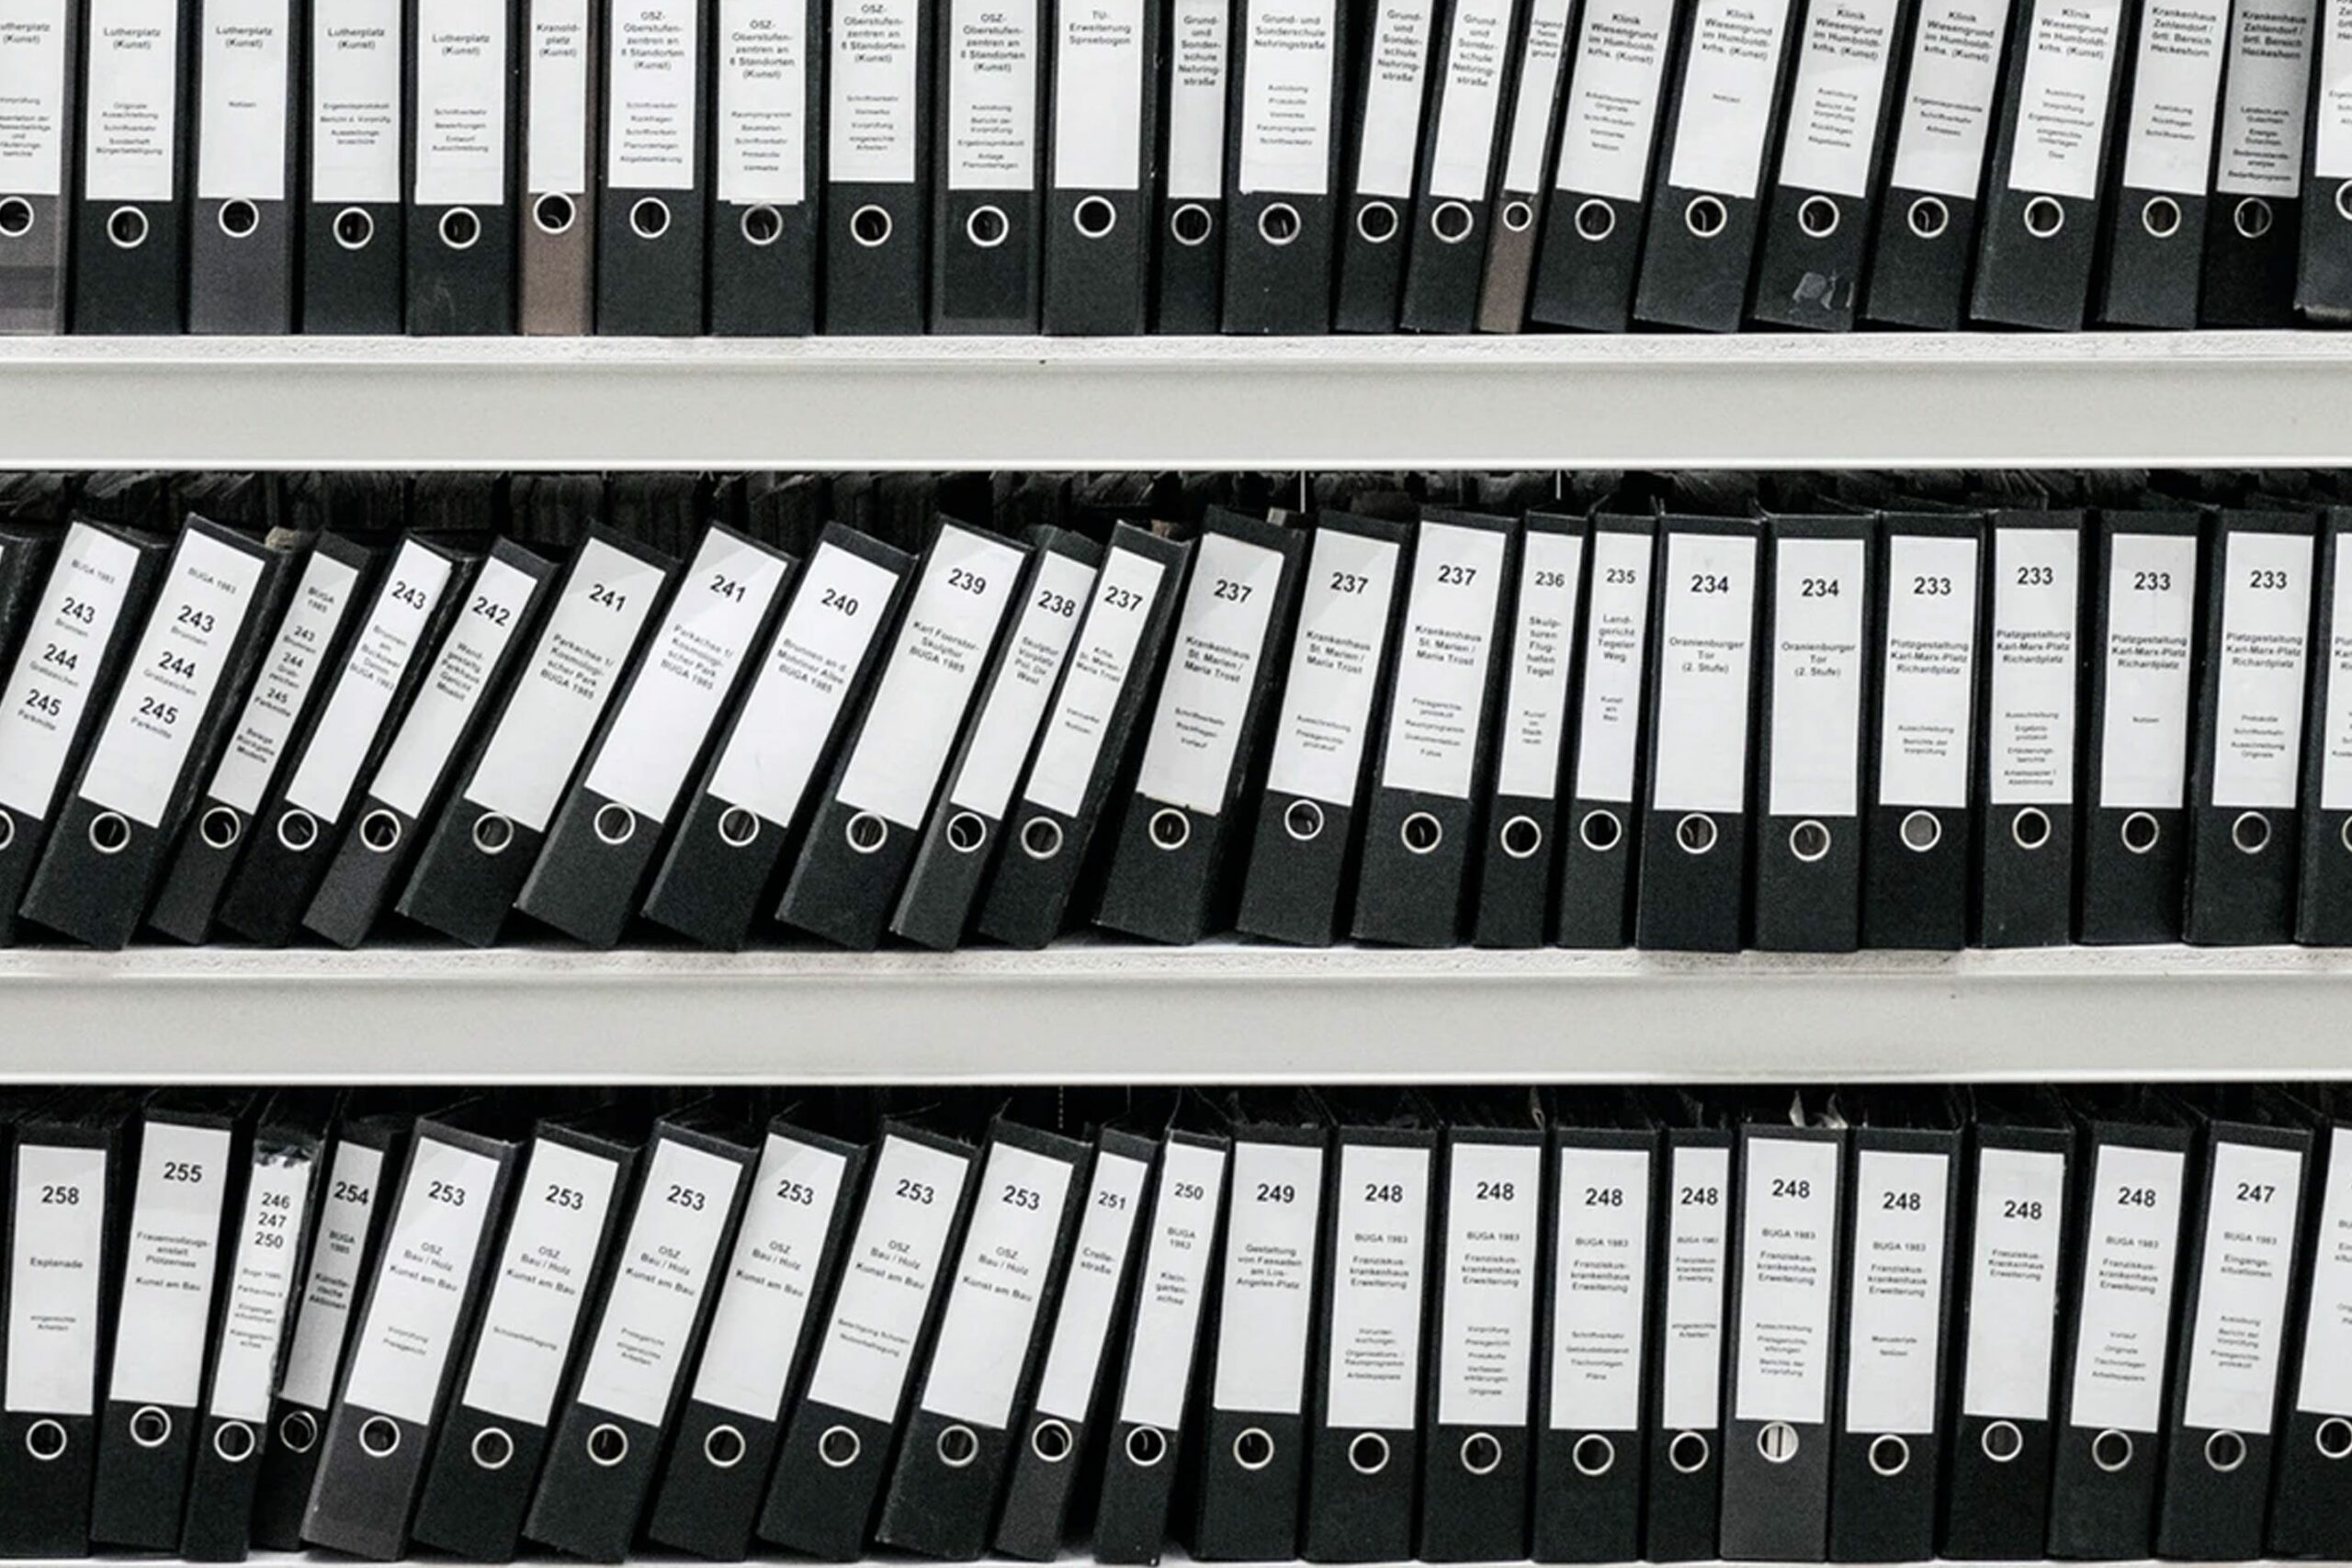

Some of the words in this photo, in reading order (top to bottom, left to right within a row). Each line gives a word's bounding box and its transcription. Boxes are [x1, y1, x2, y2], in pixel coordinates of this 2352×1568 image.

[946, 567, 988, 596] 239
[1329, 570, 1370, 595] 237
[1436, 563, 1477, 587] 237
[1534, 570, 1566, 589] 236
[1605, 567, 1636, 585] 235
[1690, 573, 1730, 595] 234
[1912, 575, 1952, 597] 233
[2016, 566, 2054, 587] 233
[2132, 570, 2172, 592] 233
[2249, 569, 2289, 591] 233
[390, 580, 427, 611] 243
[587, 582, 628, 613] 241
[708, 573, 747, 604] 241
[1102, 584, 1144, 613] 237
[1213, 578, 1254, 604] 237
[1801, 577, 1840, 599] 234
[60, 595, 96, 626] 243
[470, 594, 511, 628] 242
[820, 587, 860, 617] 240
[1036, 589, 1077, 619] 238
[176, 604, 216, 634] 243
[294, 625, 316, 643] 243
[42, 642, 79, 671] 244
[157, 650, 197, 681] 244
[281, 650, 305, 670] 244
[24, 688, 62, 717] 245
[266, 687, 289, 706] 245
[138, 695, 179, 726] 245
[162, 1160, 203, 1184] 255
[40, 1184, 81, 1206] 258
[260, 1190, 291, 1211] 246
[333, 1179, 370, 1207] 254
[427, 1179, 467, 1208] 253
[544, 1183, 584, 1212] 253
[666, 1183, 707, 1212] 253
[775, 1179, 815, 1207] 253
[895, 1178, 935, 1205] 253
[1001, 1183, 1041, 1212] 253
[1097, 1190, 1127, 1211] 251
[1173, 1181, 1205, 1201] 250
[1256, 1182, 1296, 1205] 249
[1363, 1182, 1404, 1204] 248
[1476, 1180, 1516, 1202] 248
[1584, 1187, 1624, 1208] 248
[1679, 1186, 1720, 1207] 248
[1770, 1178, 1811, 1201] 248
[2117, 1185, 2157, 1209] 248
[2235, 1181, 2277, 1204] 247
[1882, 1190, 1922, 1213] 248
[2003, 1199, 2043, 1222] 248
[257, 1211, 288, 1229] 247
[254, 1230, 285, 1250] 250
